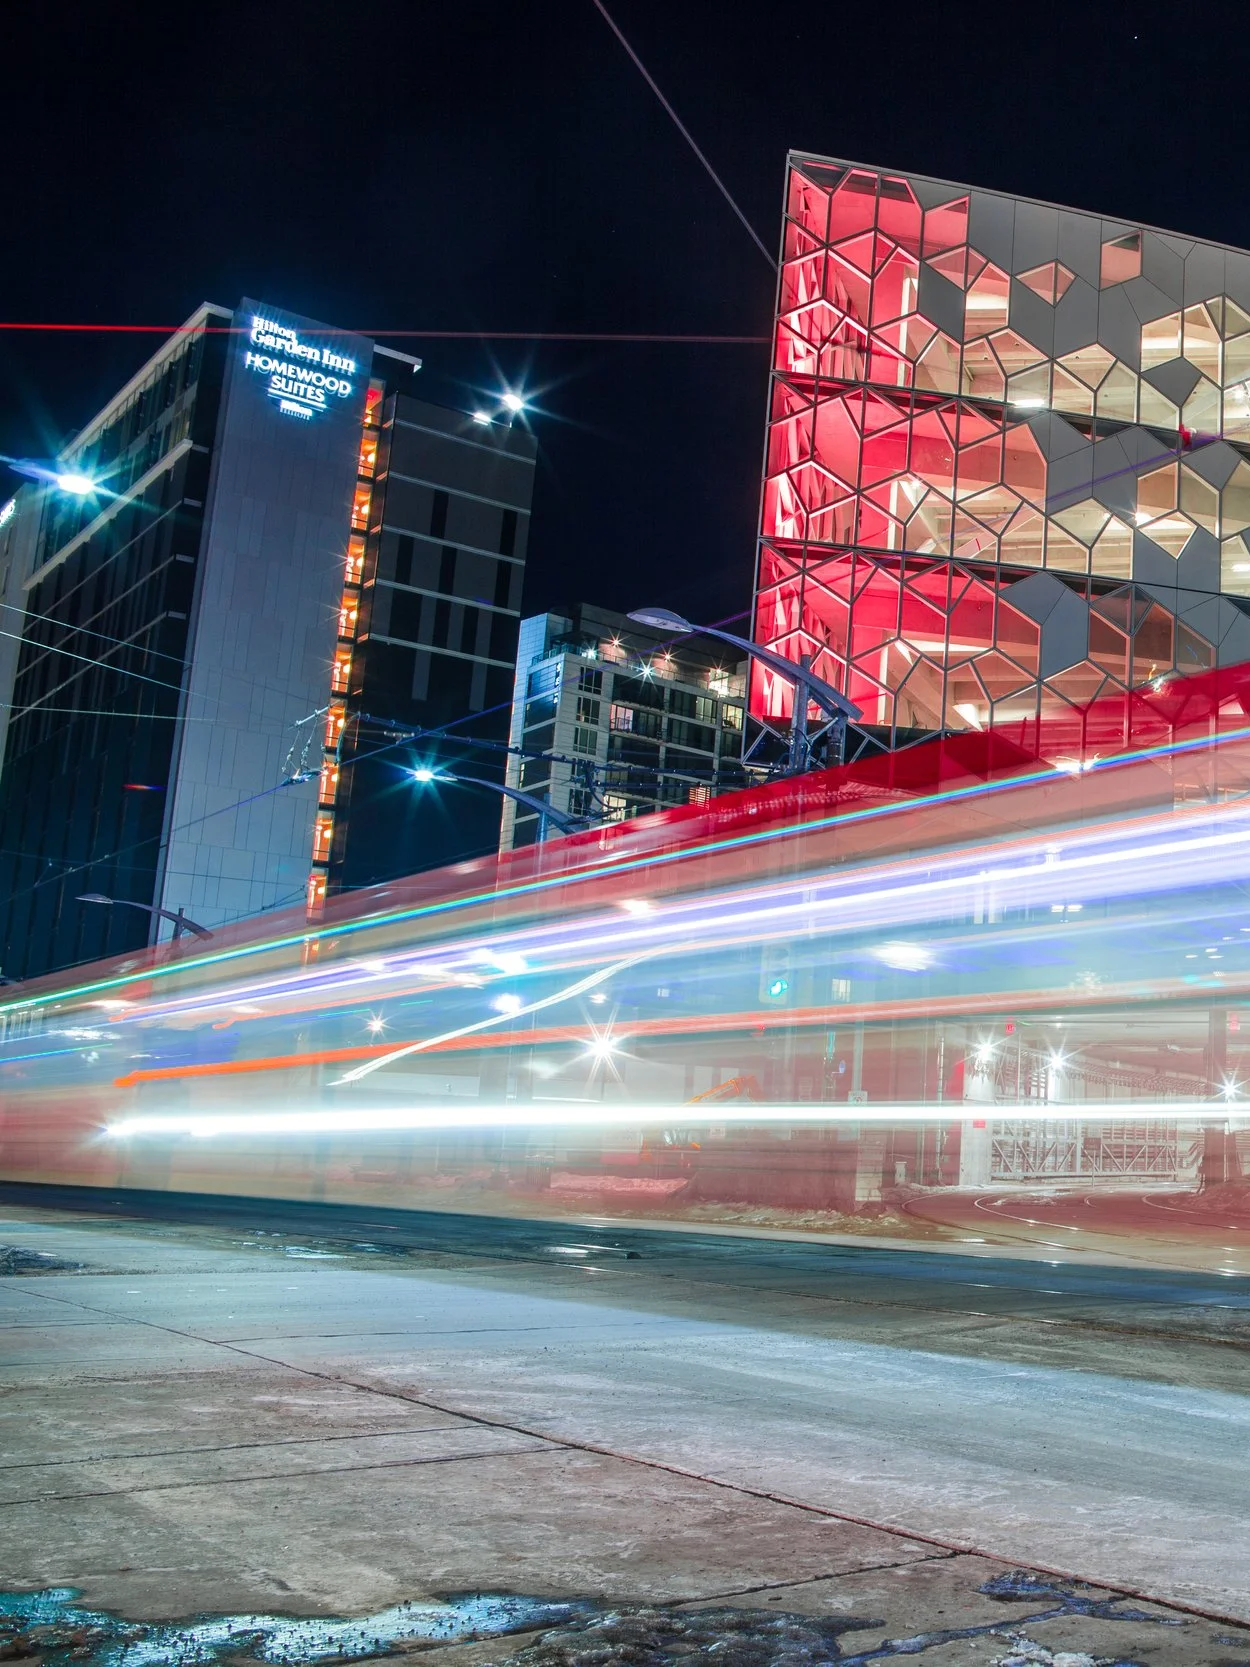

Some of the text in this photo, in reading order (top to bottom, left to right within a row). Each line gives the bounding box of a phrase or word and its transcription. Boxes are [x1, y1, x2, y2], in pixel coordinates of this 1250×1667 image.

[252, 316, 297, 341] Hilton
[250, 328, 355, 372] Garden Inn
[246, 351, 352, 395] HOMEWOOD
[270, 375, 325, 402] SUITES
